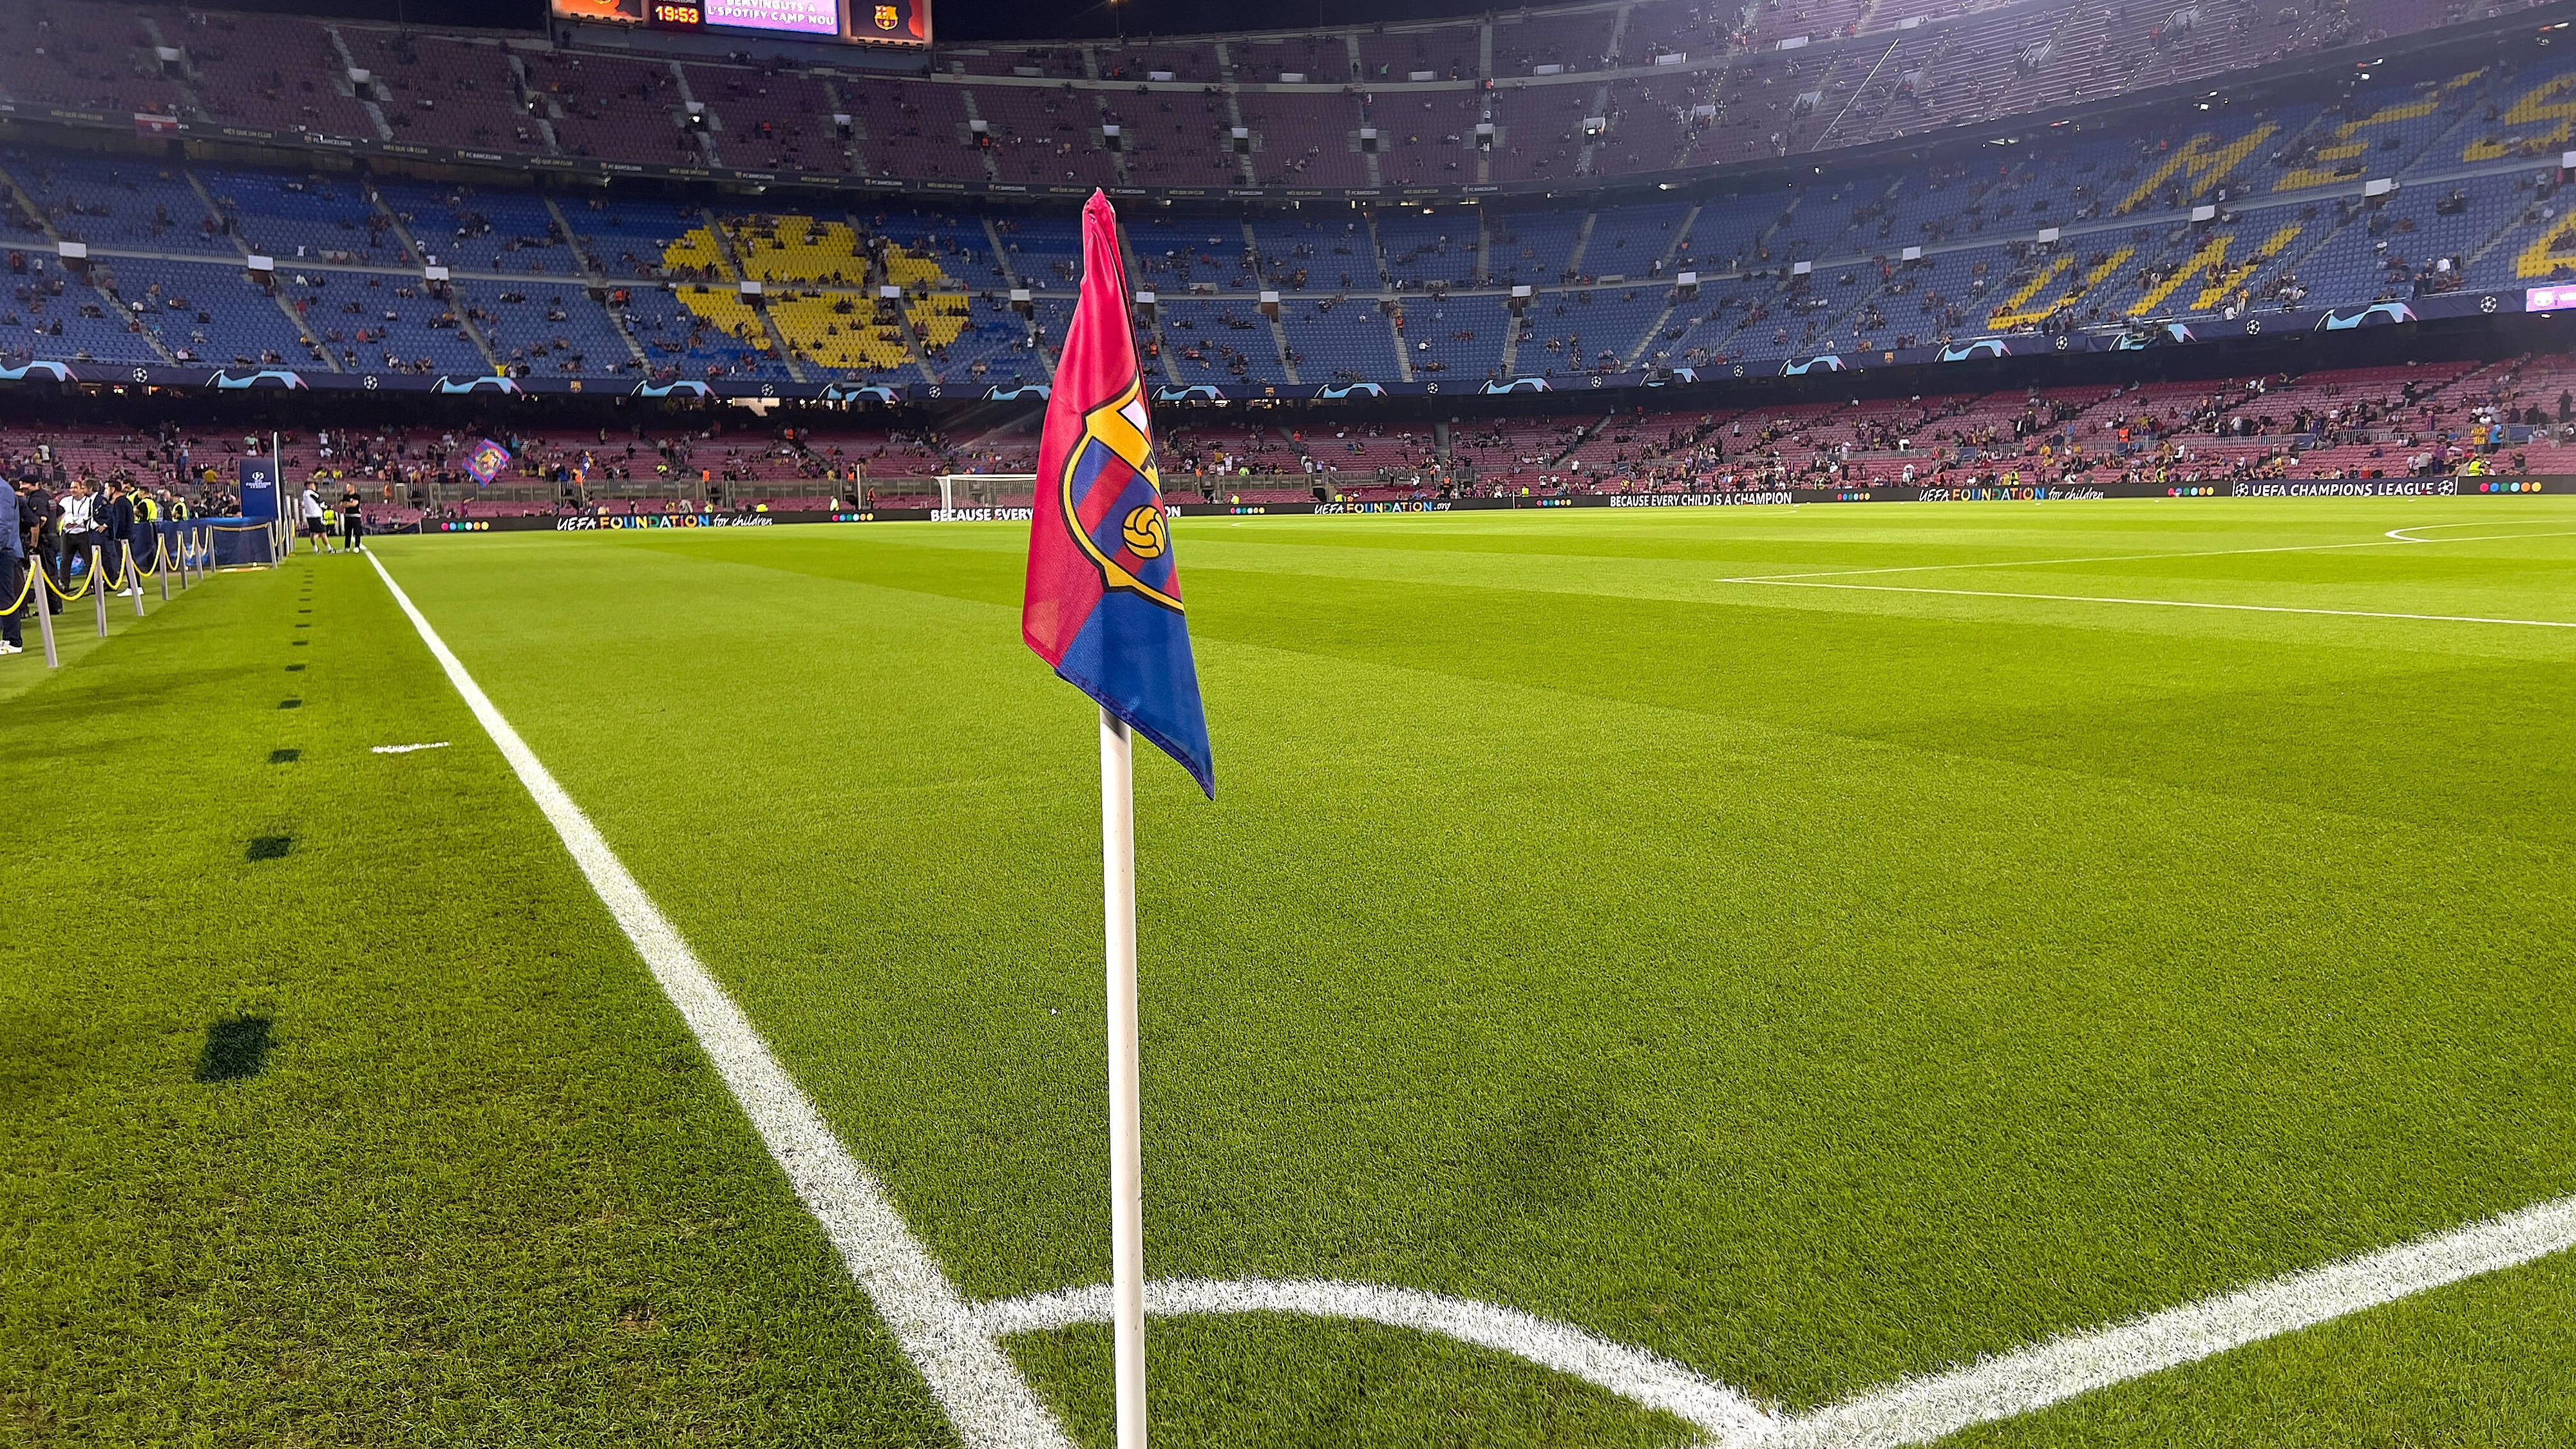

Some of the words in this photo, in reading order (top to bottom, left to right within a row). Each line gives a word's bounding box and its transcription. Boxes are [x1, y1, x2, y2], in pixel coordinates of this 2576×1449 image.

[656, 6, 699, 24] 19:53
[808, 3, 816, 12] A
[706, 6, 768, 20] L'SPOTIFY
[770, 11, 806, 24] CAMP
[807, 15, 835, 26] NOU
[1919, 488, 1950, 502] UEFA
[1953, 487, 2045, 501] FOUNDATION
[2048, 487, 2063, 500] for
[2064, 487, 2105, 500] children
[2253, 484, 2287, 497] UEFA
[2291, 483, 2372, 497] CHAMPIONS
[2378, 482, 2434, 496] LEAGUE
[1610, 495, 1649, 507] BECAUSE
[1651, 494, 1680, 507] EVERY
[1681, 494, 1710, 507] CHILD
[1713, 493, 1722, 506] IS
[1724, 493, 1732, 506] A
[1734, 492, 1793, 506] CHAMPION
[931, 508, 992, 522] BECAUSE
[994, 507, 1034, 521] EVERY
[1314, 504, 1344, 515] UEFA
[556, 517, 597, 531] UEFA
[599, 515, 710, 530] FOUNDATION
[713, 513, 730, 527] for
[732, 513, 773, 527] children
